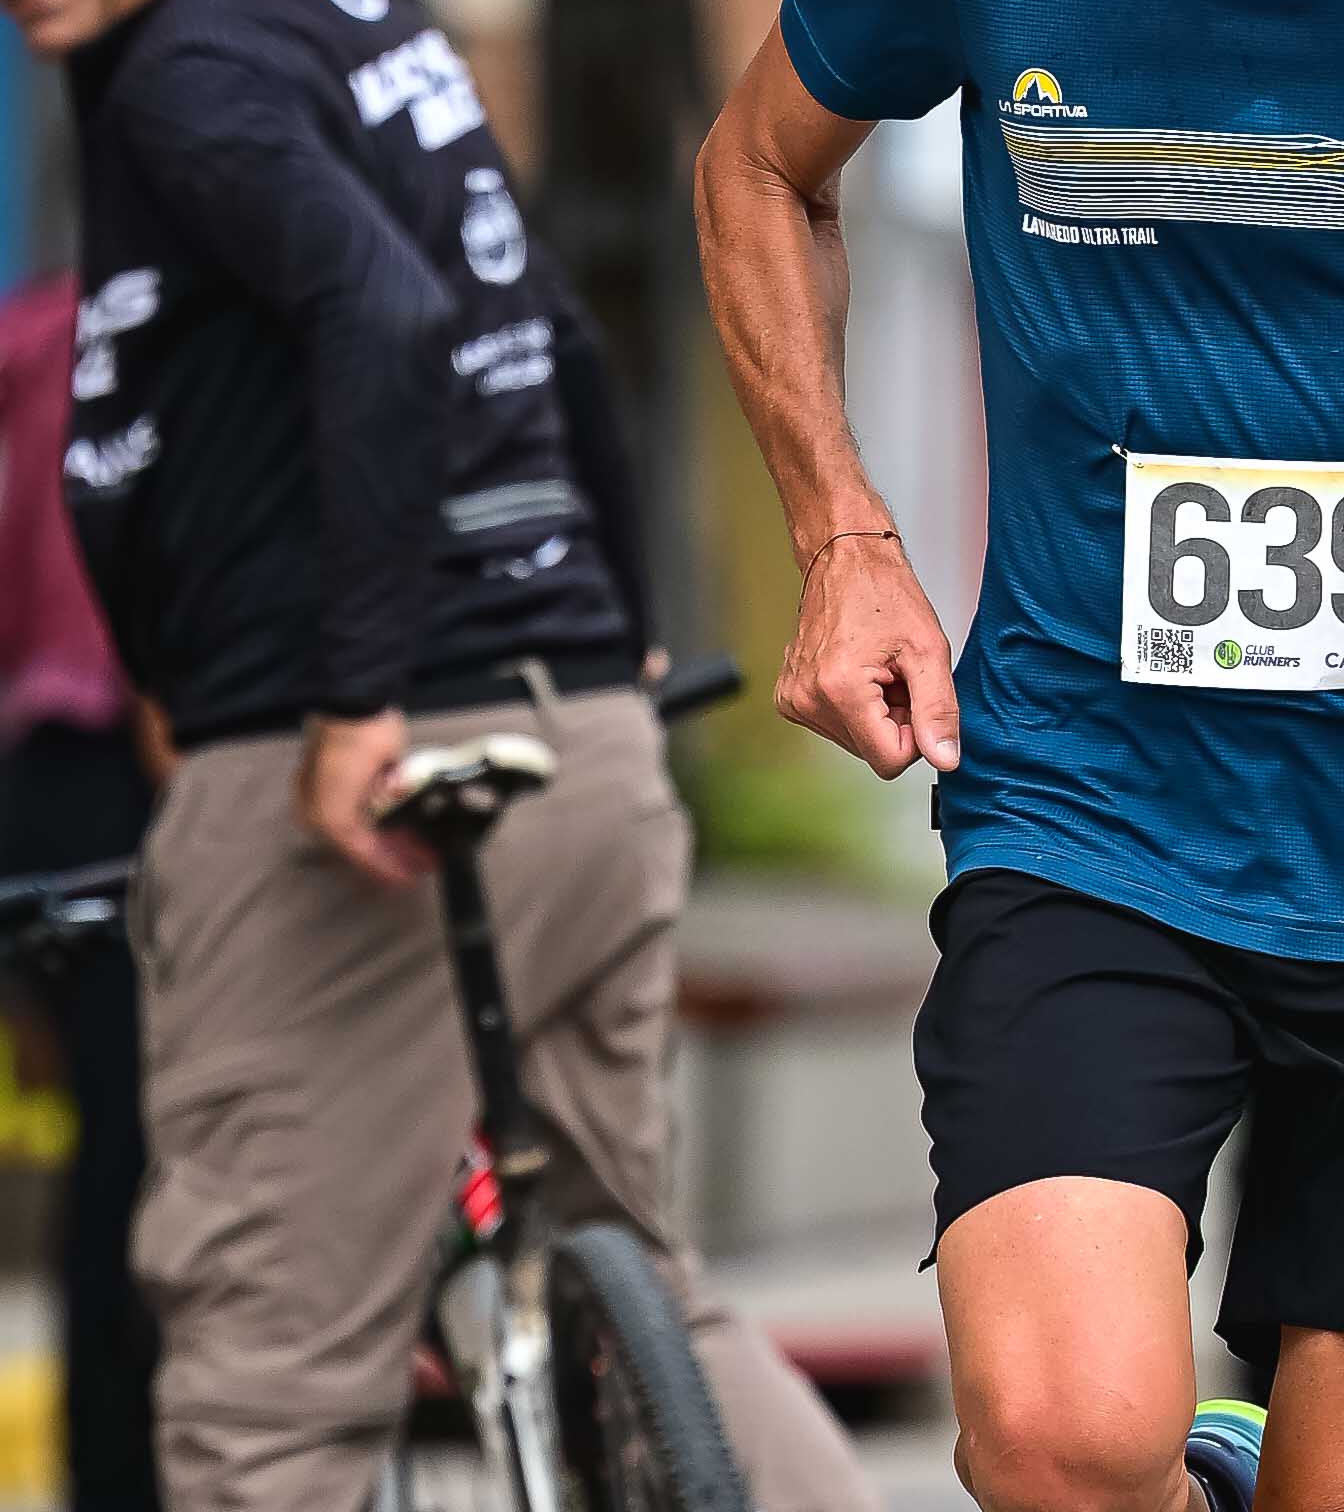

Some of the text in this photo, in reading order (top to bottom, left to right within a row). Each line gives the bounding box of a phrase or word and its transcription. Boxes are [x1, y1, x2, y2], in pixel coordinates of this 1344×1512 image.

[1013, 104, 1088, 118] SPORTIVA
[1022, 213, 1159, 246] LAVAREDO ULTRA TRAIL
[1245, 644, 1275, 656] CLUB
